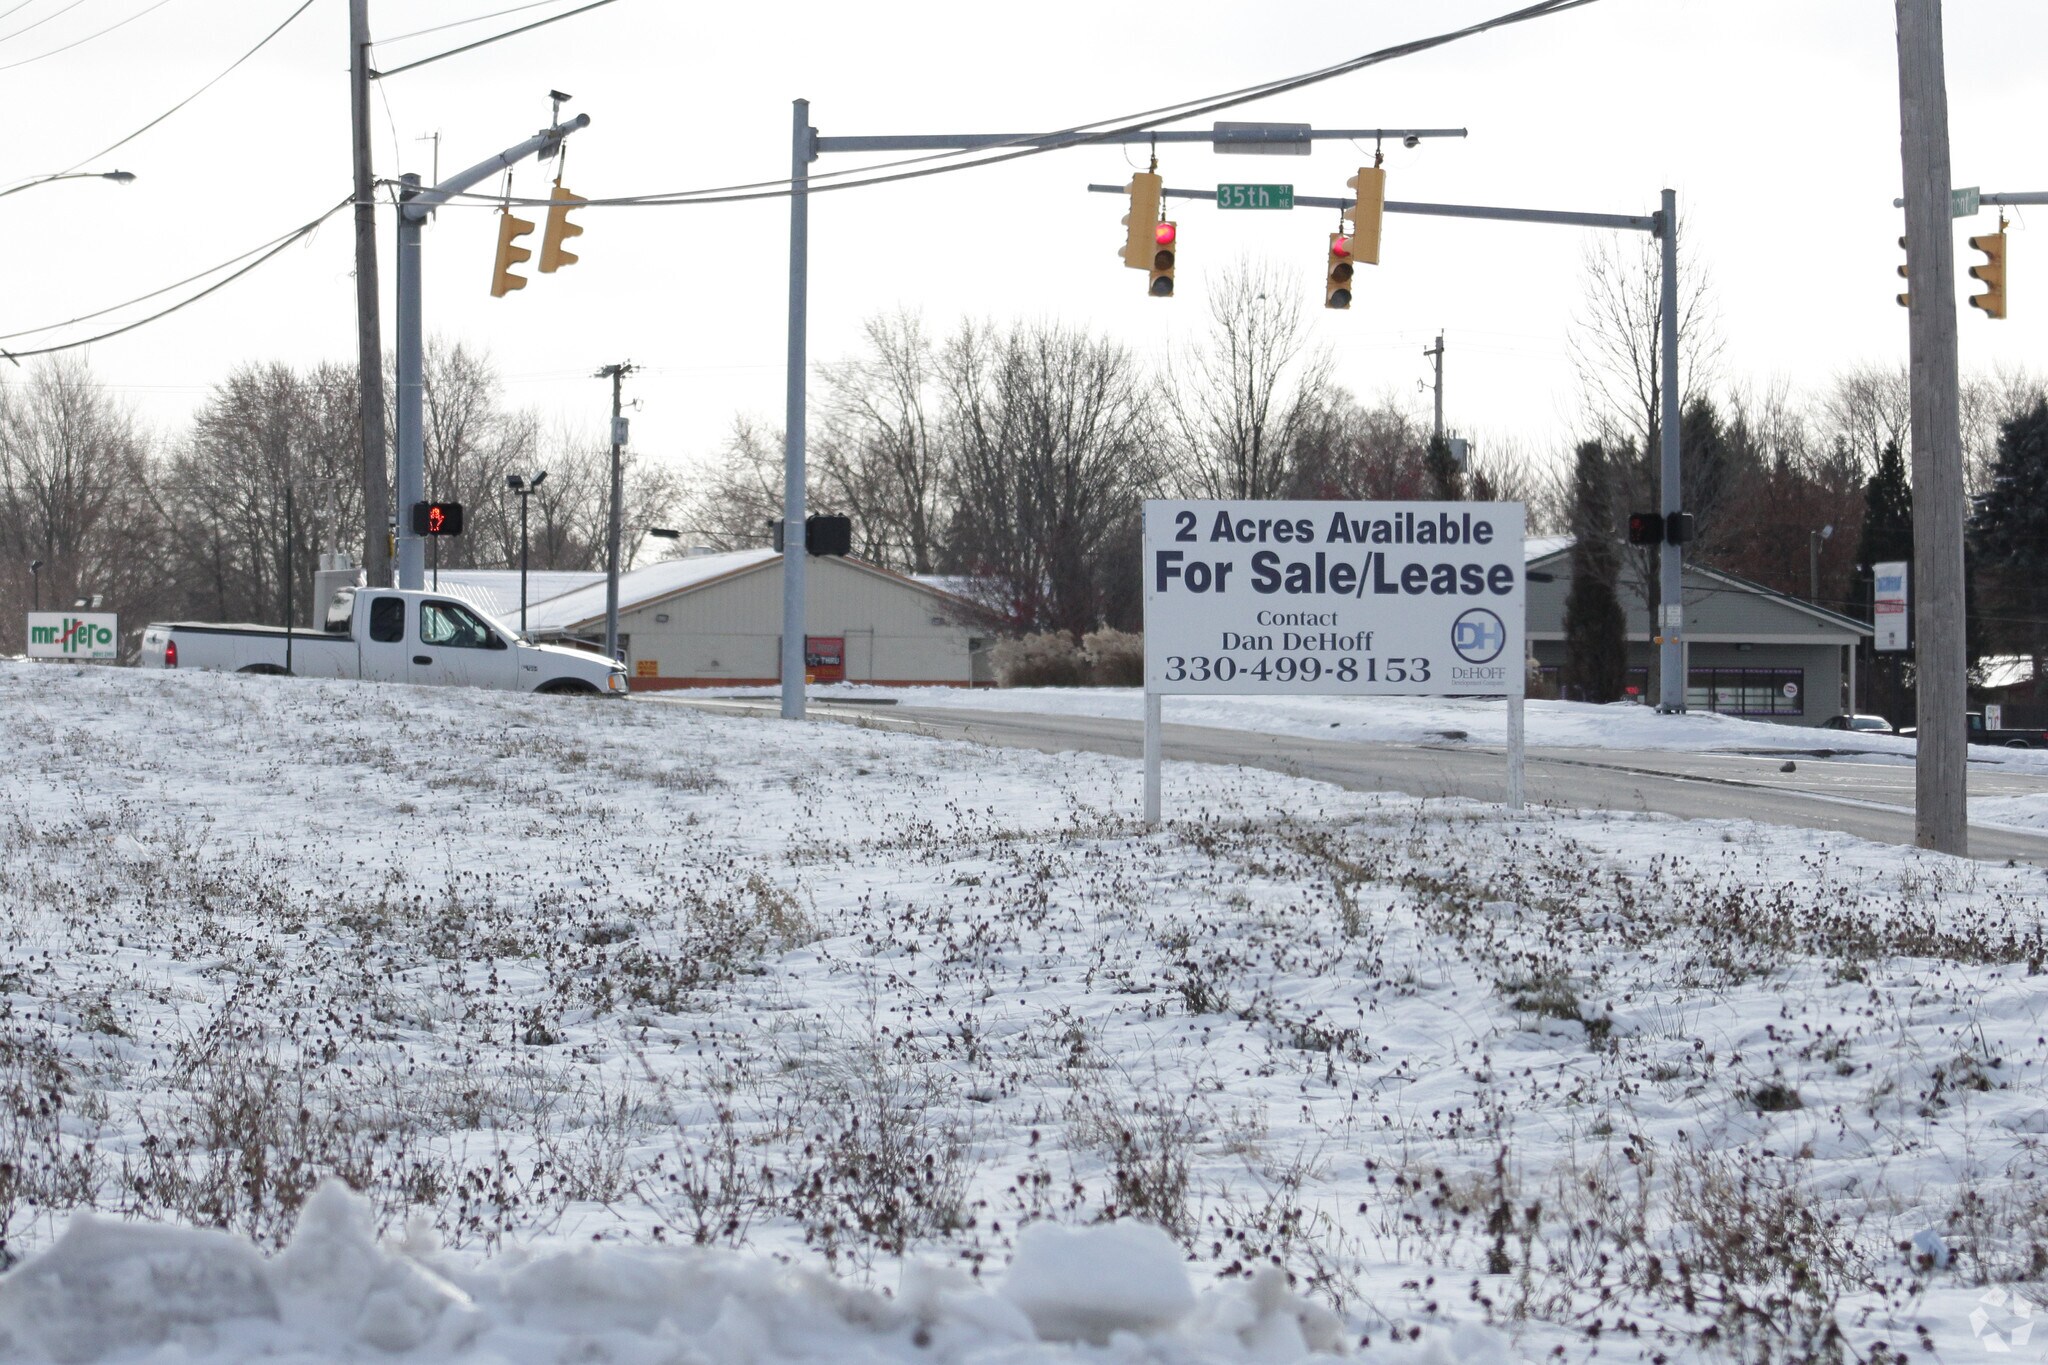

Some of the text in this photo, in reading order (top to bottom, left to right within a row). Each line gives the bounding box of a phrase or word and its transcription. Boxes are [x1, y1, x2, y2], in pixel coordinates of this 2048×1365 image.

[1219, 185, 1270, 207] 35th
[1279, 198, 1289, 208] NE
[1174, 510, 1494, 546] 2 Acres Available
[1155, 550, 1515, 599] For Sale/Lease
[1256, 610, 1339, 627] Contact
[1222, 631, 1375, 652] Dan DeHoff
[1165, 655, 1432, 683] 330-499-8153
